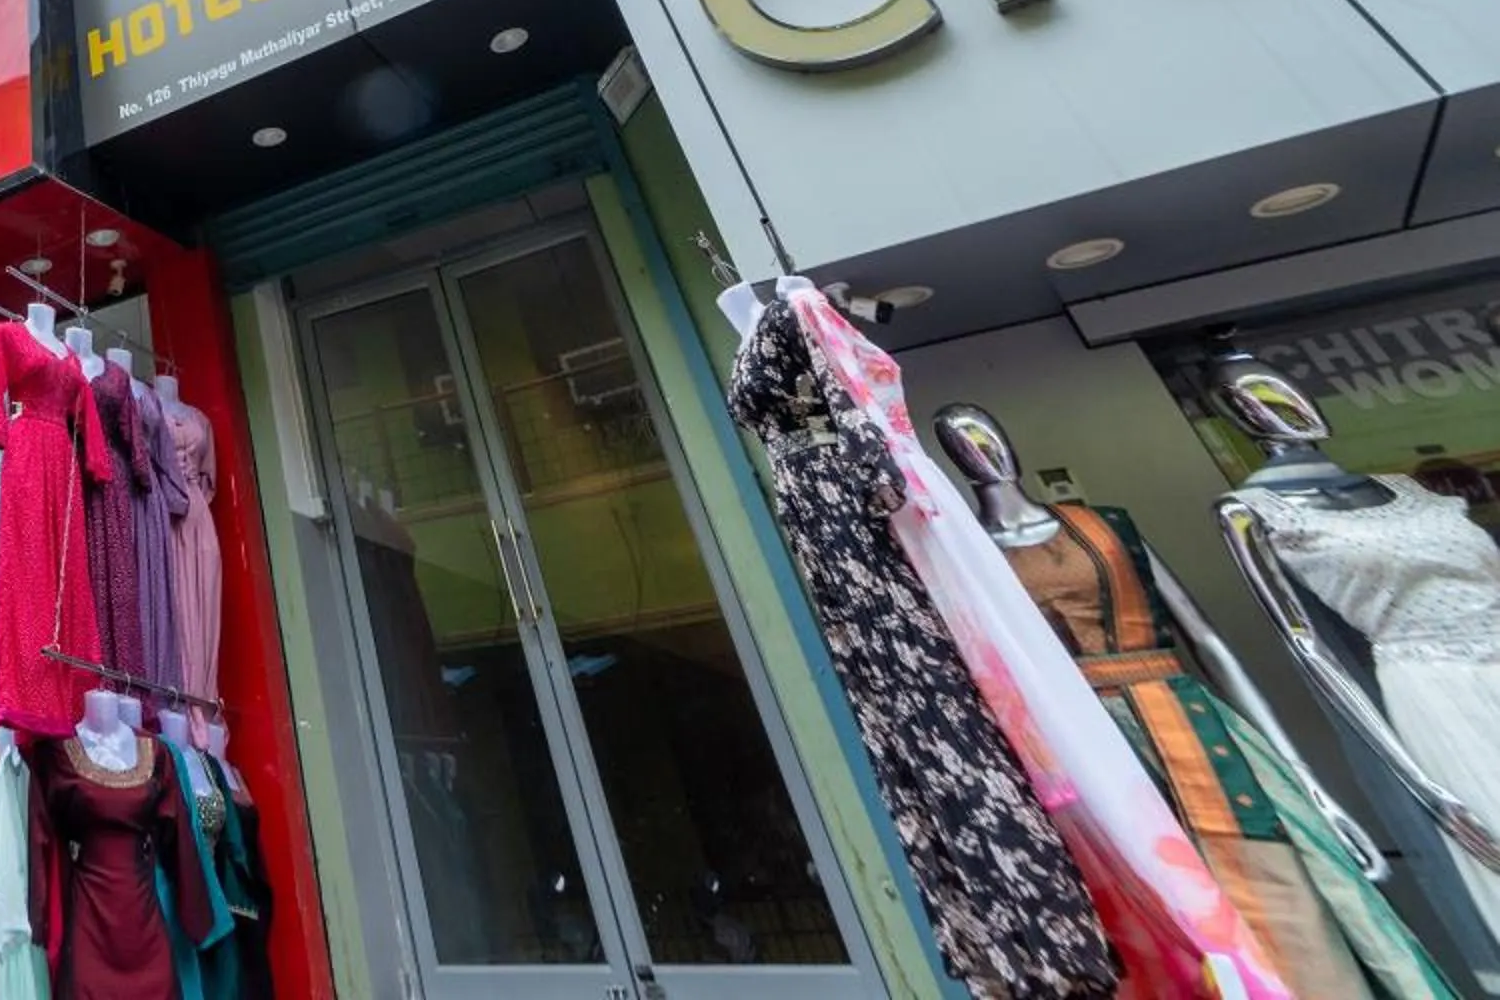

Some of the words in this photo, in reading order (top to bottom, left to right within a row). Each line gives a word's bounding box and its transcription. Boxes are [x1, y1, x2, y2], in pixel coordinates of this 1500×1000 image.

[118, 102, 143, 119] No.
[145, 85, 171, 107] 126
[177, 60, 237, 93] Thiyagu
[239, 20, 321, 70] Muthaliyar
[1258, 303, 1500, 379] CHITR
